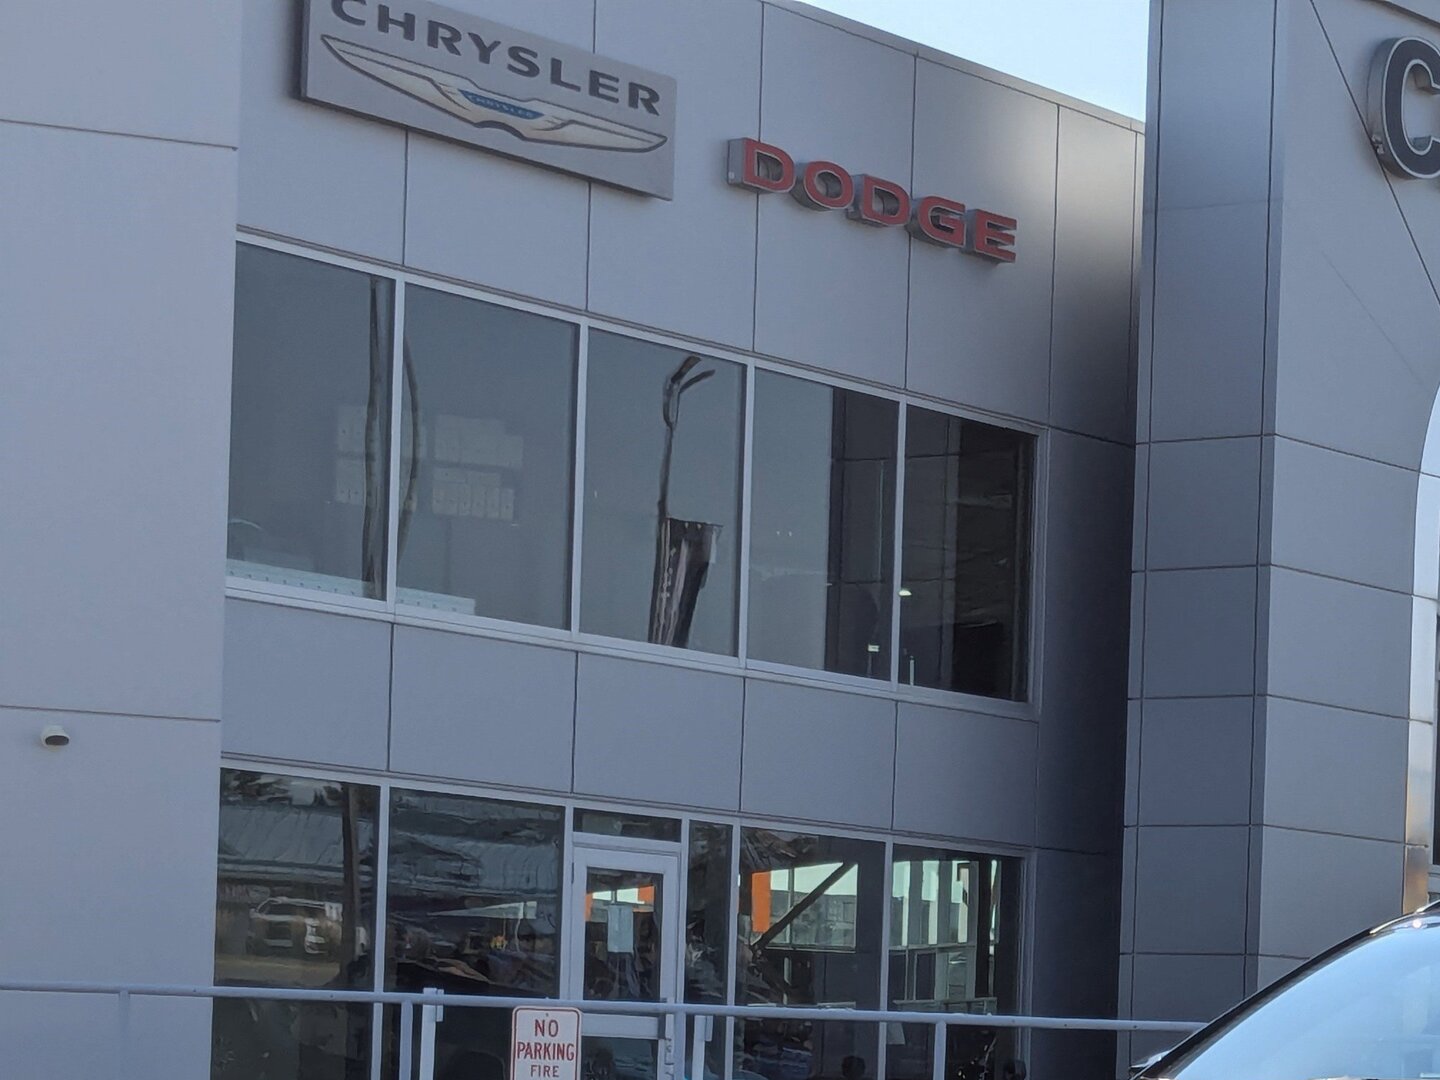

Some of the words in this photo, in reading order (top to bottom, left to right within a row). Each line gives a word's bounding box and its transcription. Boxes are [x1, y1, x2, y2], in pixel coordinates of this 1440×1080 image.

[331, 0, 661, 117] CHRYSLER
[736, 137, 1017, 264] DODGE
[534, 1018, 559, 1038] NO
[517, 1041, 575, 1062] PARKING
[530, 1065, 560, 1078] FIRE
